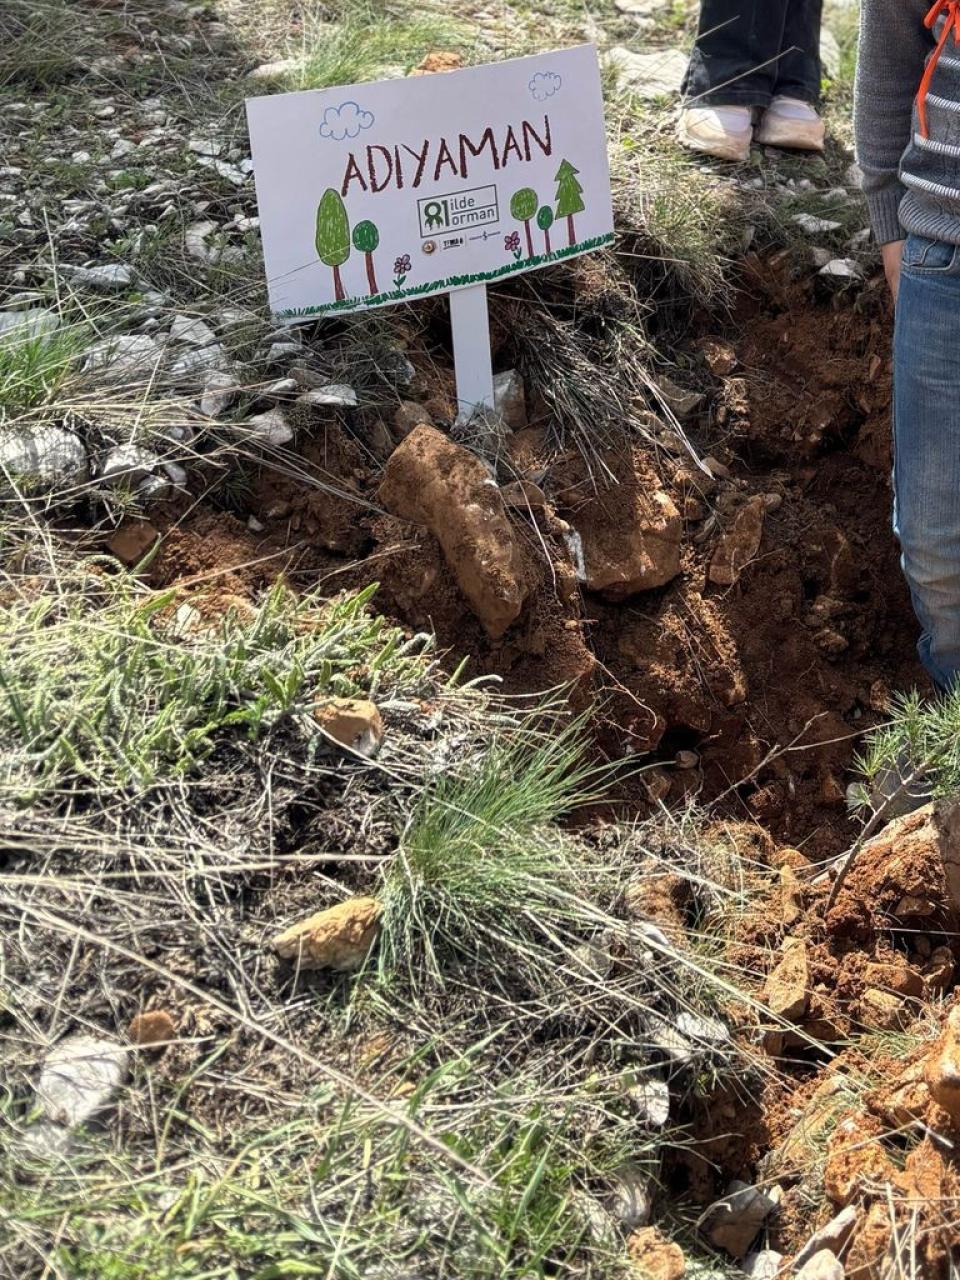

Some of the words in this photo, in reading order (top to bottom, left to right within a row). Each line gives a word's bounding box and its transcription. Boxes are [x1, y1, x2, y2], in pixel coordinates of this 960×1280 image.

[341, 114, 552, 197] ADIYAMAN
[450, 196, 475, 211] ilde
[452, 208, 495, 226] orman
